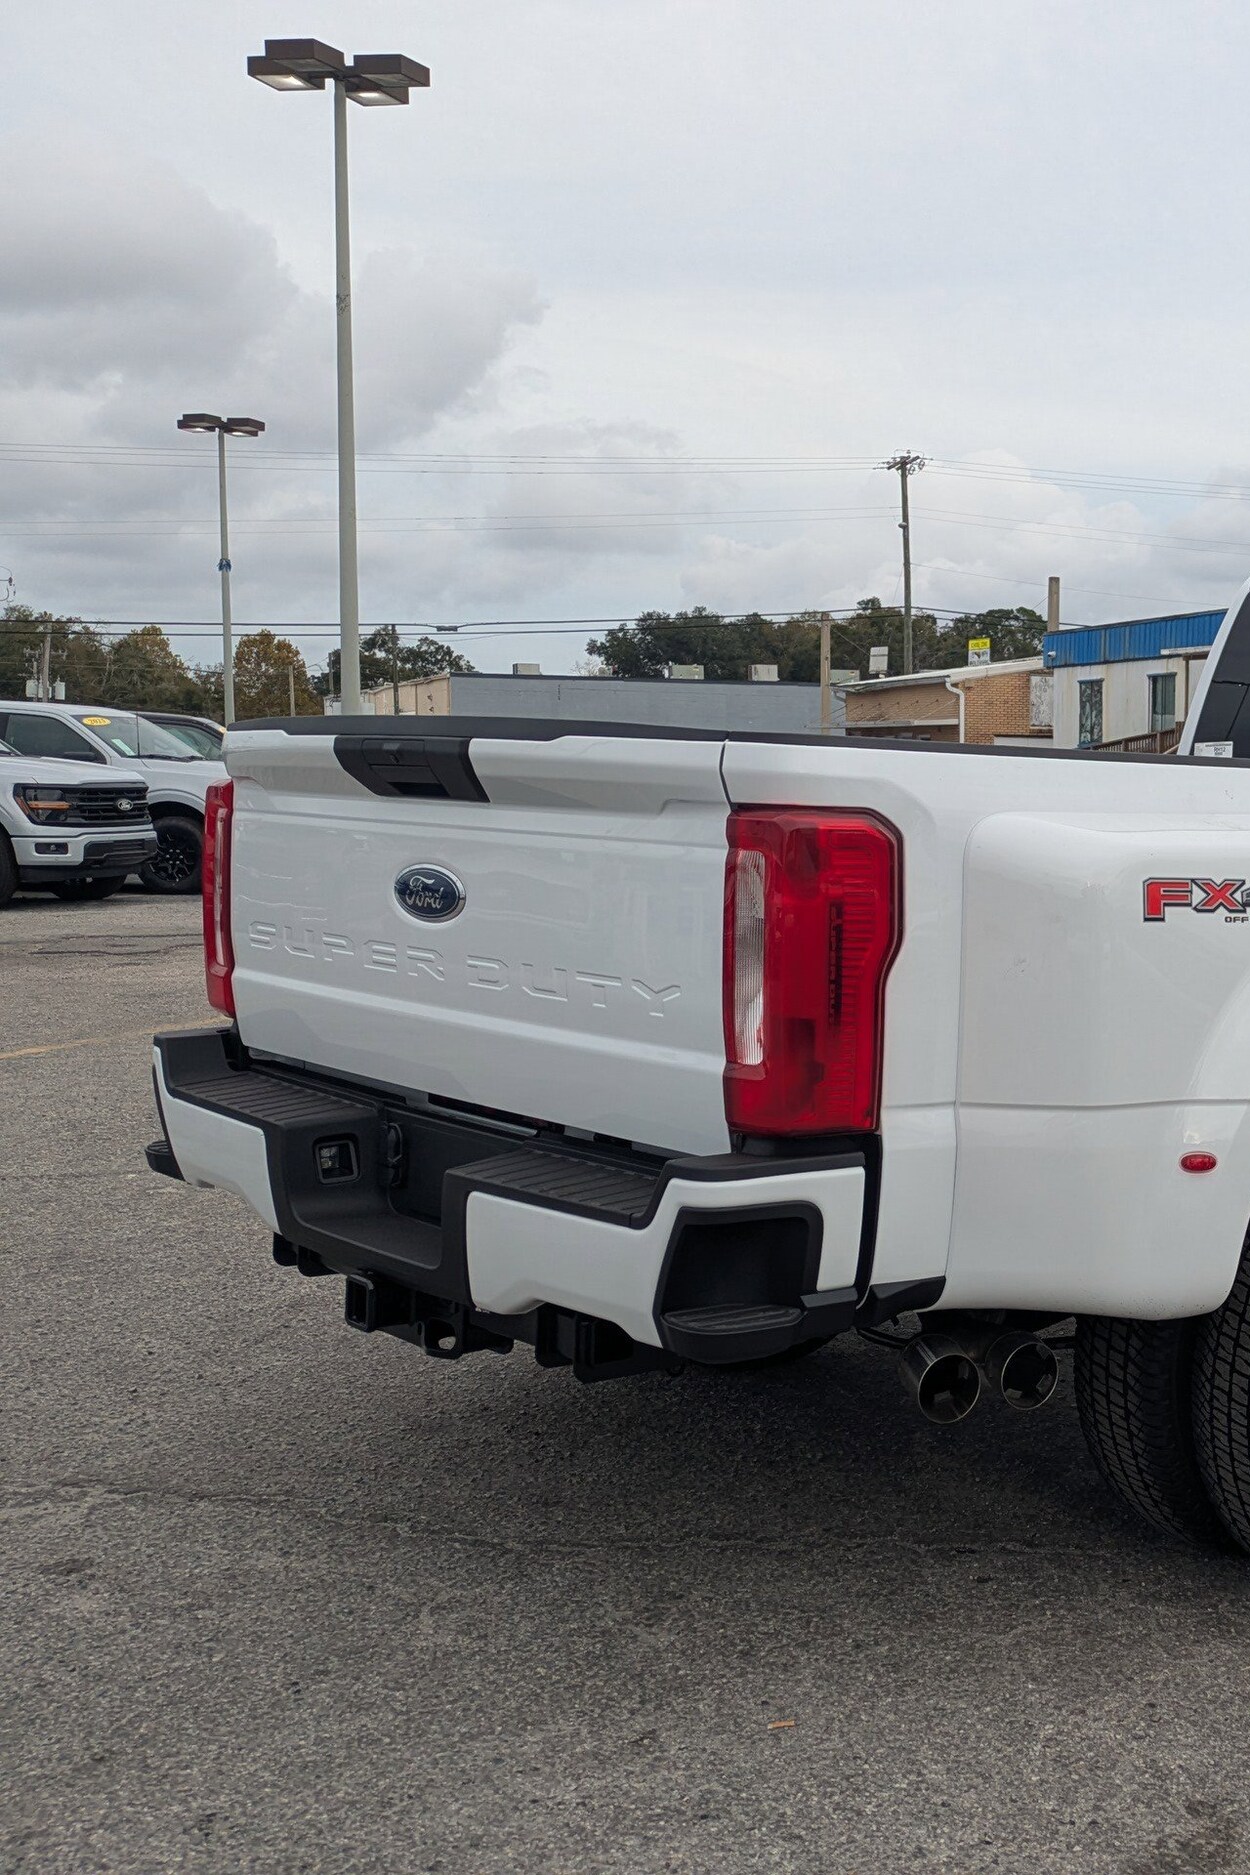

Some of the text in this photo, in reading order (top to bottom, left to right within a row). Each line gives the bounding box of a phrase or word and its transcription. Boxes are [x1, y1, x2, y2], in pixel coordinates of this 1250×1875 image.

[406, 875, 444, 909] Ford
[249, 921, 682, 1017] SUPER DUTY
